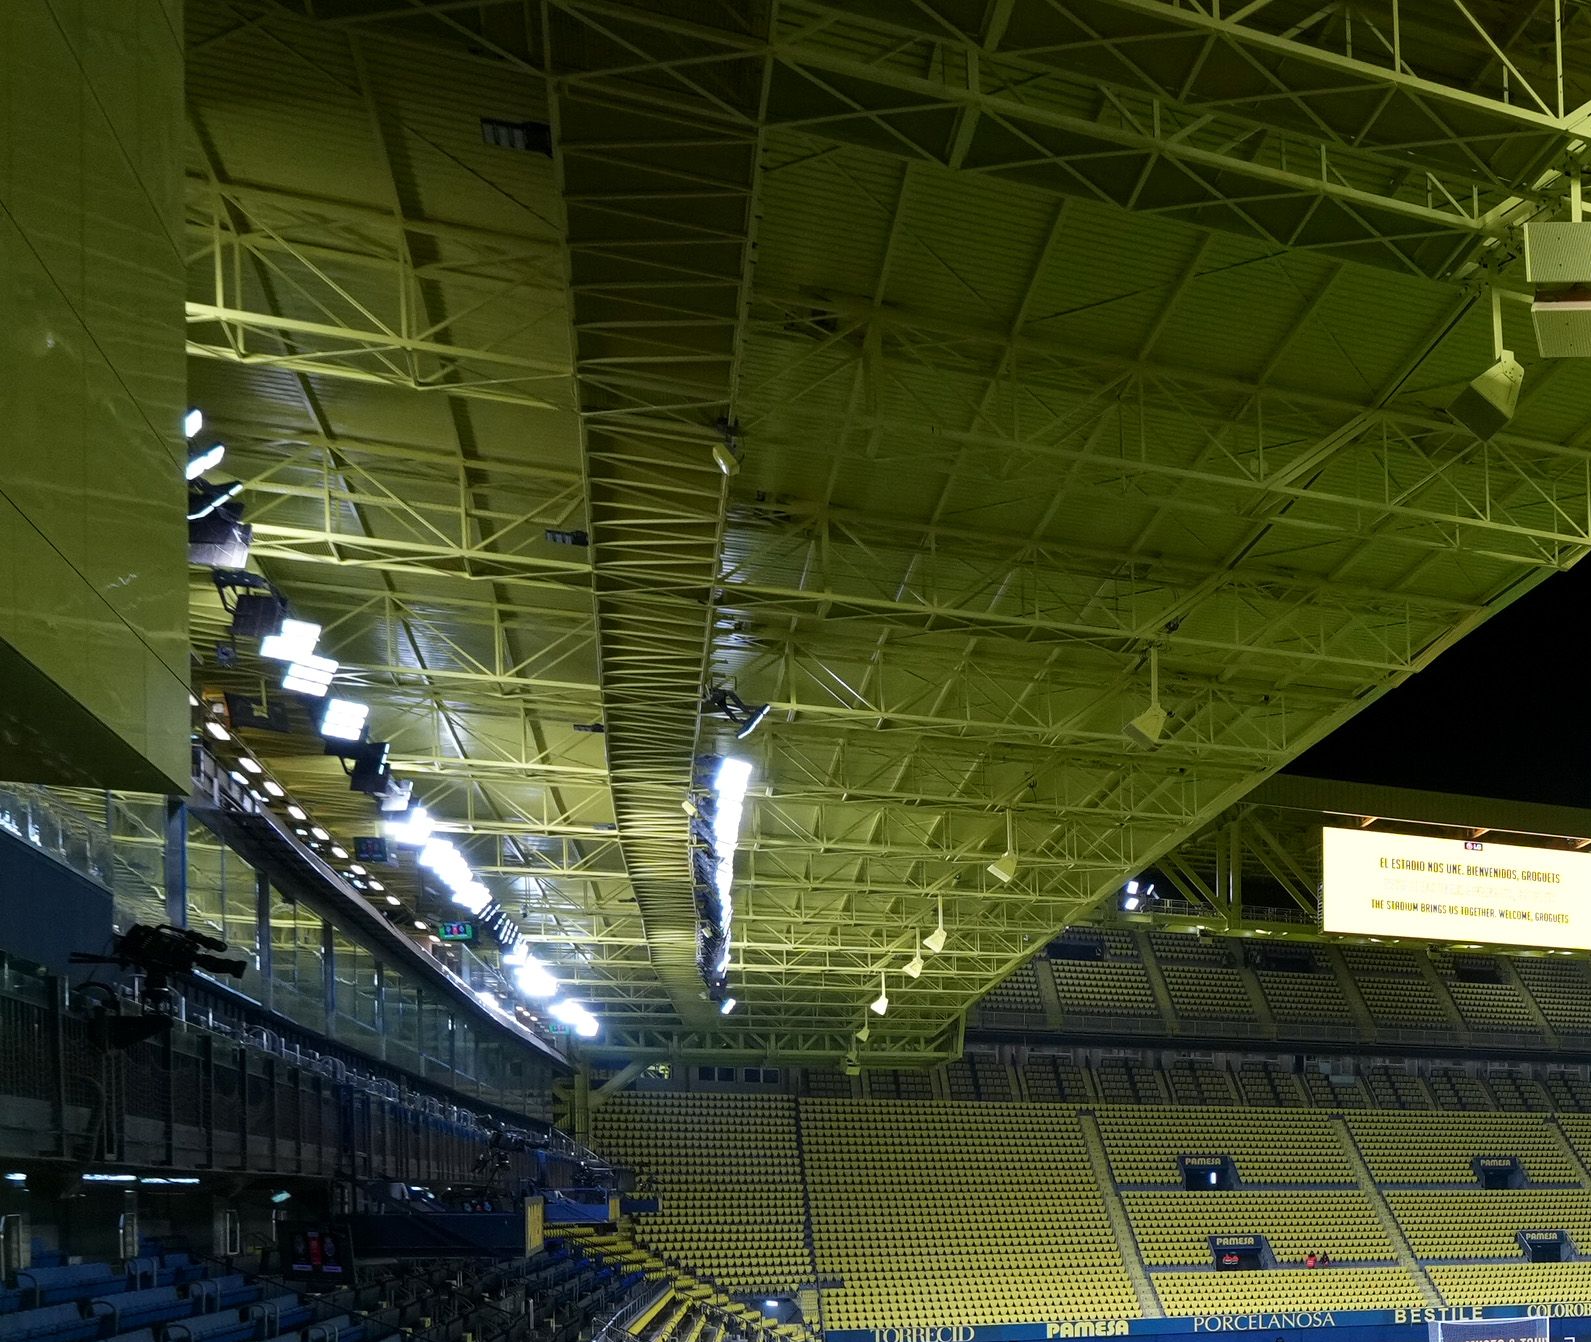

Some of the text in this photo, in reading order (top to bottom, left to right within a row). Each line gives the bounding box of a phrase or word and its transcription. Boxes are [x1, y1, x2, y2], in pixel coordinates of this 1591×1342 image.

[1380, 857, 1388, 868] EL
[1391, 859, 1425, 871] ESTADIO
[1428, 862, 1444, 873] NOS
[1521, 871, 1560, 883] GROGUETS
[1372, 899, 1384, 909] THE
[1387, 901, 1418, 911] STADIUM
[1421, 903, 1447, 914] BRINGS
[1449, 906, 1458, 915] US
[1535, 913, 1569, 923] GROGUETS
[1216, 1237, 1254, 1246] PAMESA
[1194, 1312, 1335, 1332] PORCELANOSA
[1394, 1306, 1483, 1324] BESTILE
[1046, 1320, 1129, 1339] PAMESA
